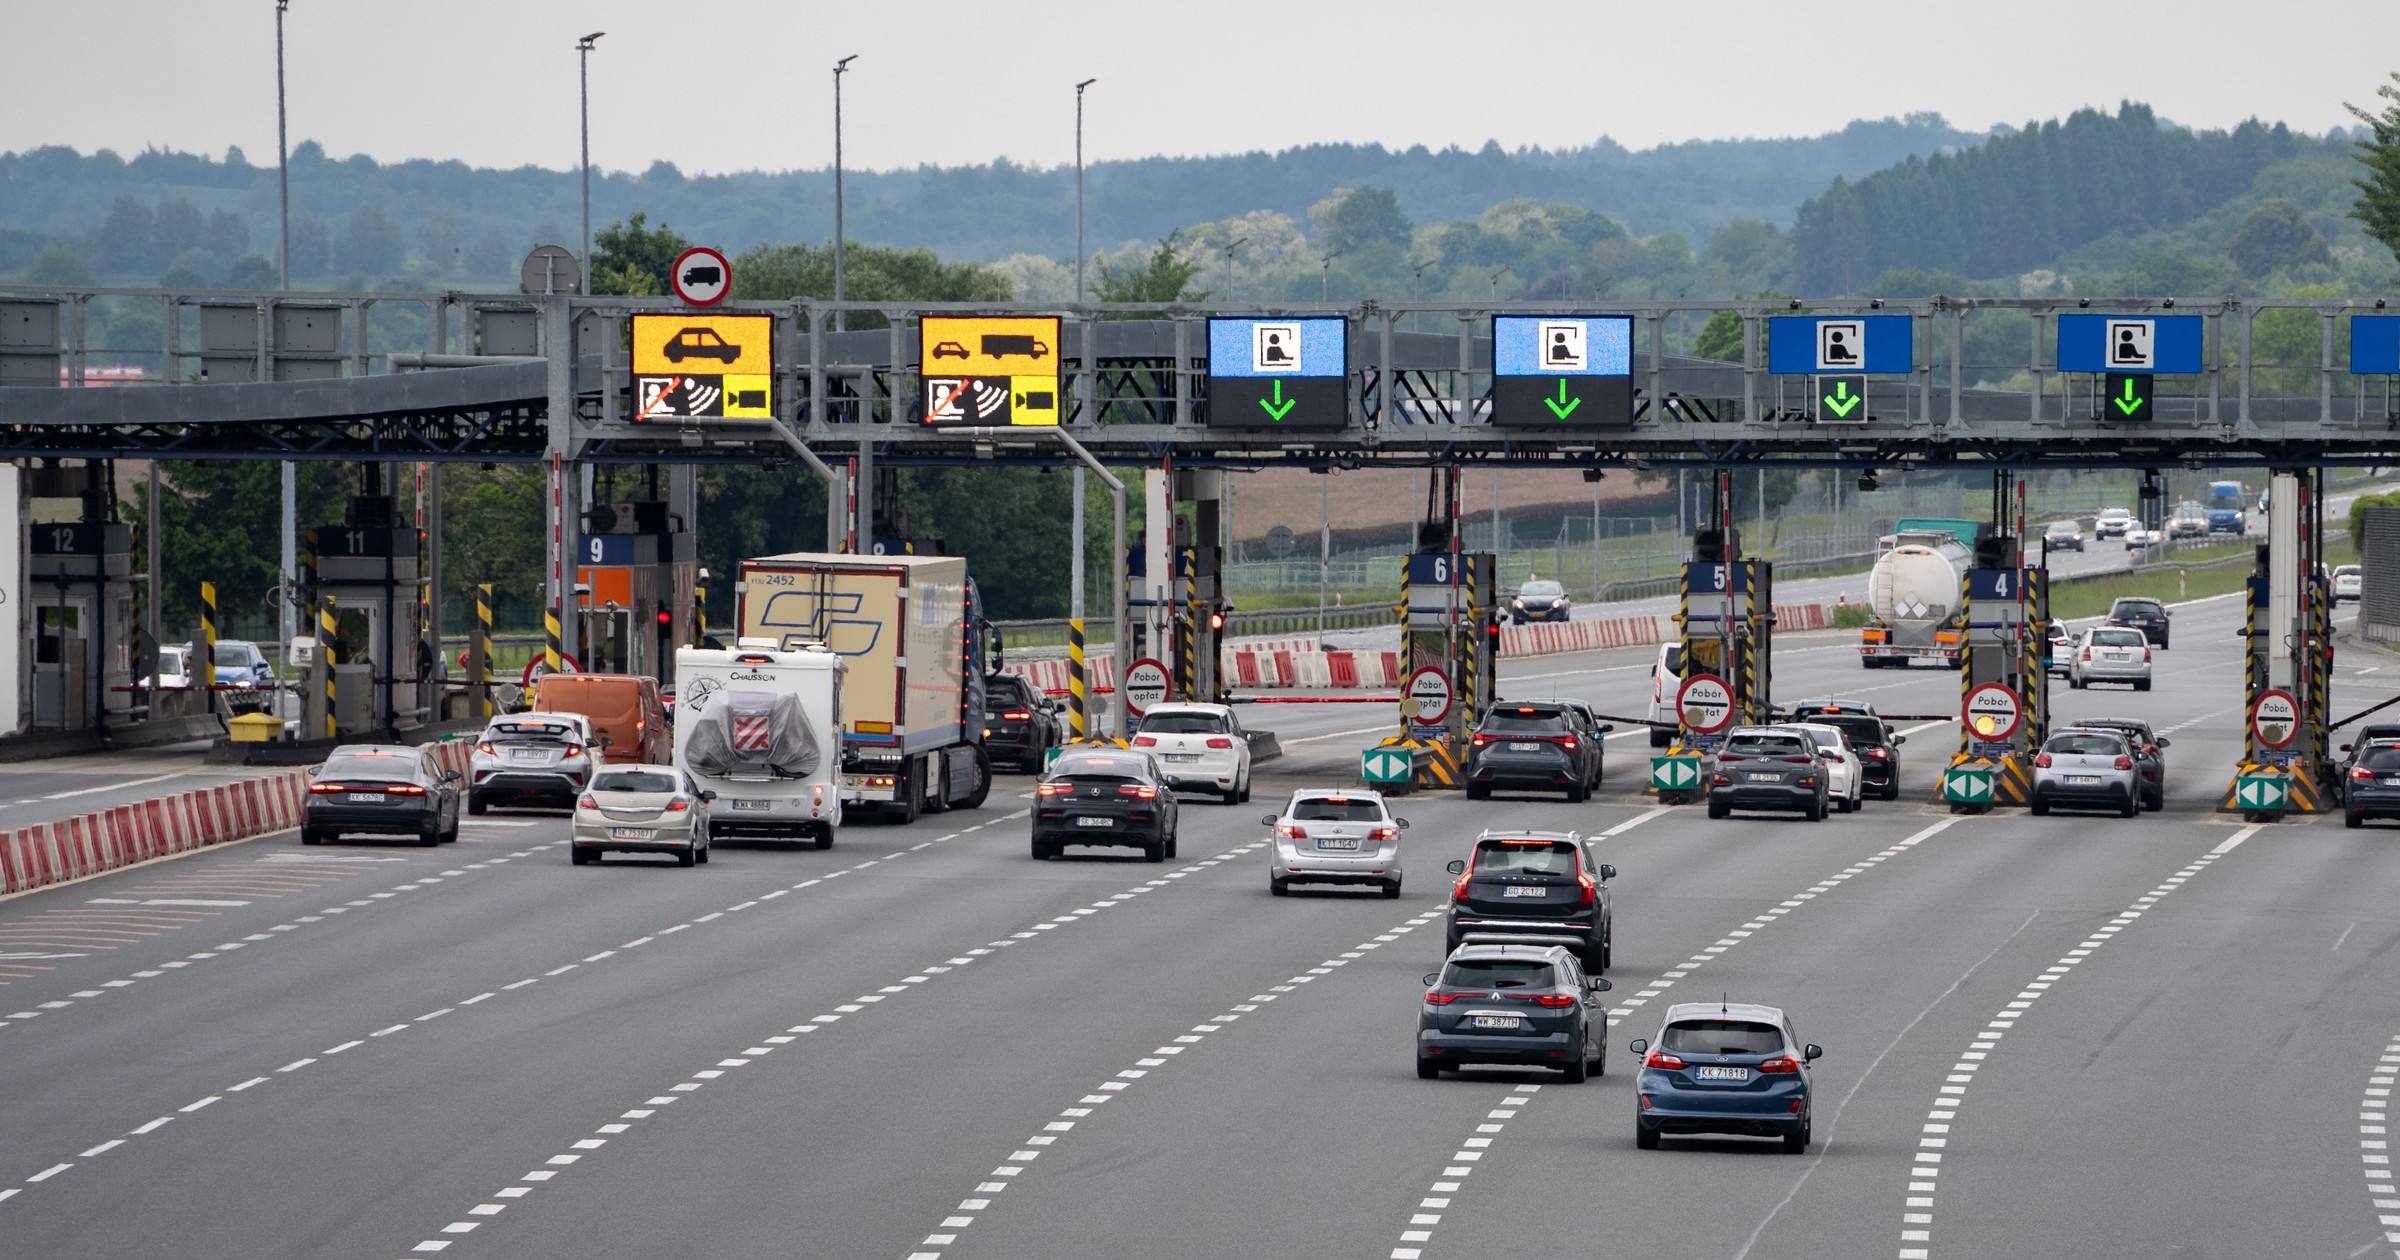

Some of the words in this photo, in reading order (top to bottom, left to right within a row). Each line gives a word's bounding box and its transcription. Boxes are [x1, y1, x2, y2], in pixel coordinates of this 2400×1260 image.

[52, 528, 74, 552] 12
[346, 531, 364, 554] 11
[590, 537, 604, 563] 9
[1434, 557, 1447, 583] 6
[766, 575, 795, 586] 2452
[1713, 565, 1726, 590] 5
[1995, 573, 2008, 597] 4
[2308, 580, 2318, 605] 3
[1134, 672, 1160, 682] Pobór
[1417, 680, 1442, 690] Pobór
[1134, 691, 1159, 703] opłat
[1691, 688, 1722, 698] Pobór
[1977, 696, 2008, 706] Pobór
[2264, 703, 2289, 713] Pobór
[1508, 887, 1519, 895] GD
[1477, 1018, 1489, 1026] WW
[1491, 1018, 1518, 1027] 387TH
[1701, 1067, 1714, 1077] KK
[1717, 1068, 1746, 1078] 71818
